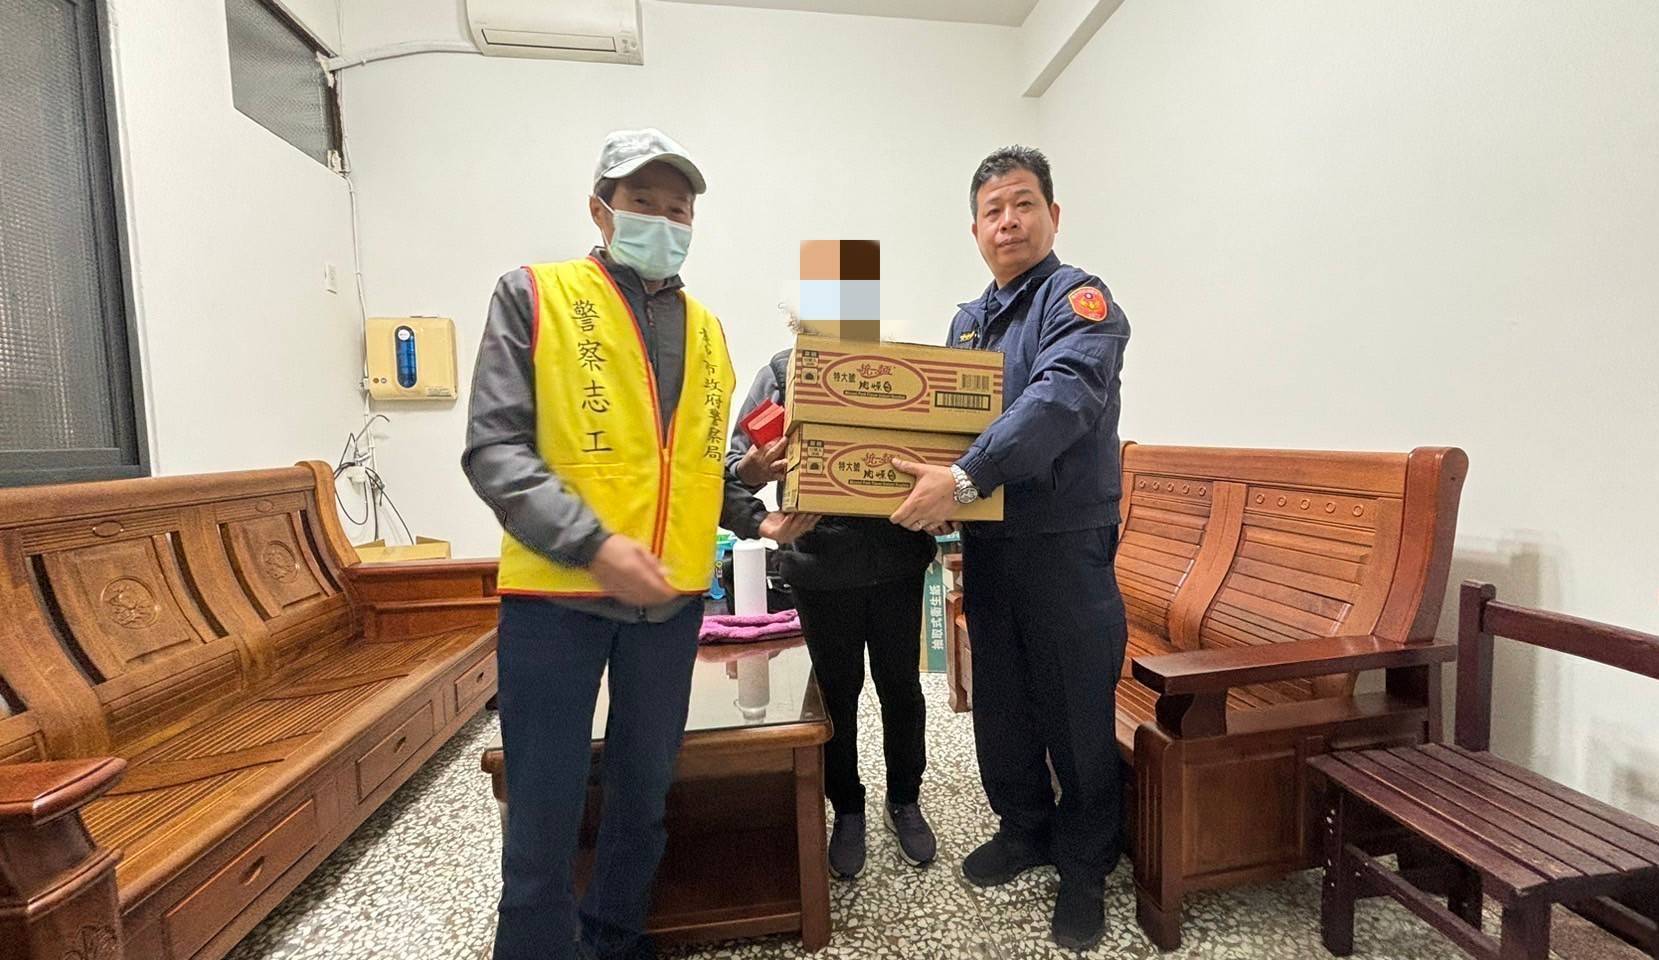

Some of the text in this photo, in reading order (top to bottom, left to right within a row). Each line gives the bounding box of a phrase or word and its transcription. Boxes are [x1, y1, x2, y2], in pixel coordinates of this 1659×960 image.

[571, 299, 613, 454] 警察志工
[832, 372, 857, 383] 特大號
[838, 461, 861, 472] 特大號
[929, 585, 945, 650] 抽取式衛生紙
